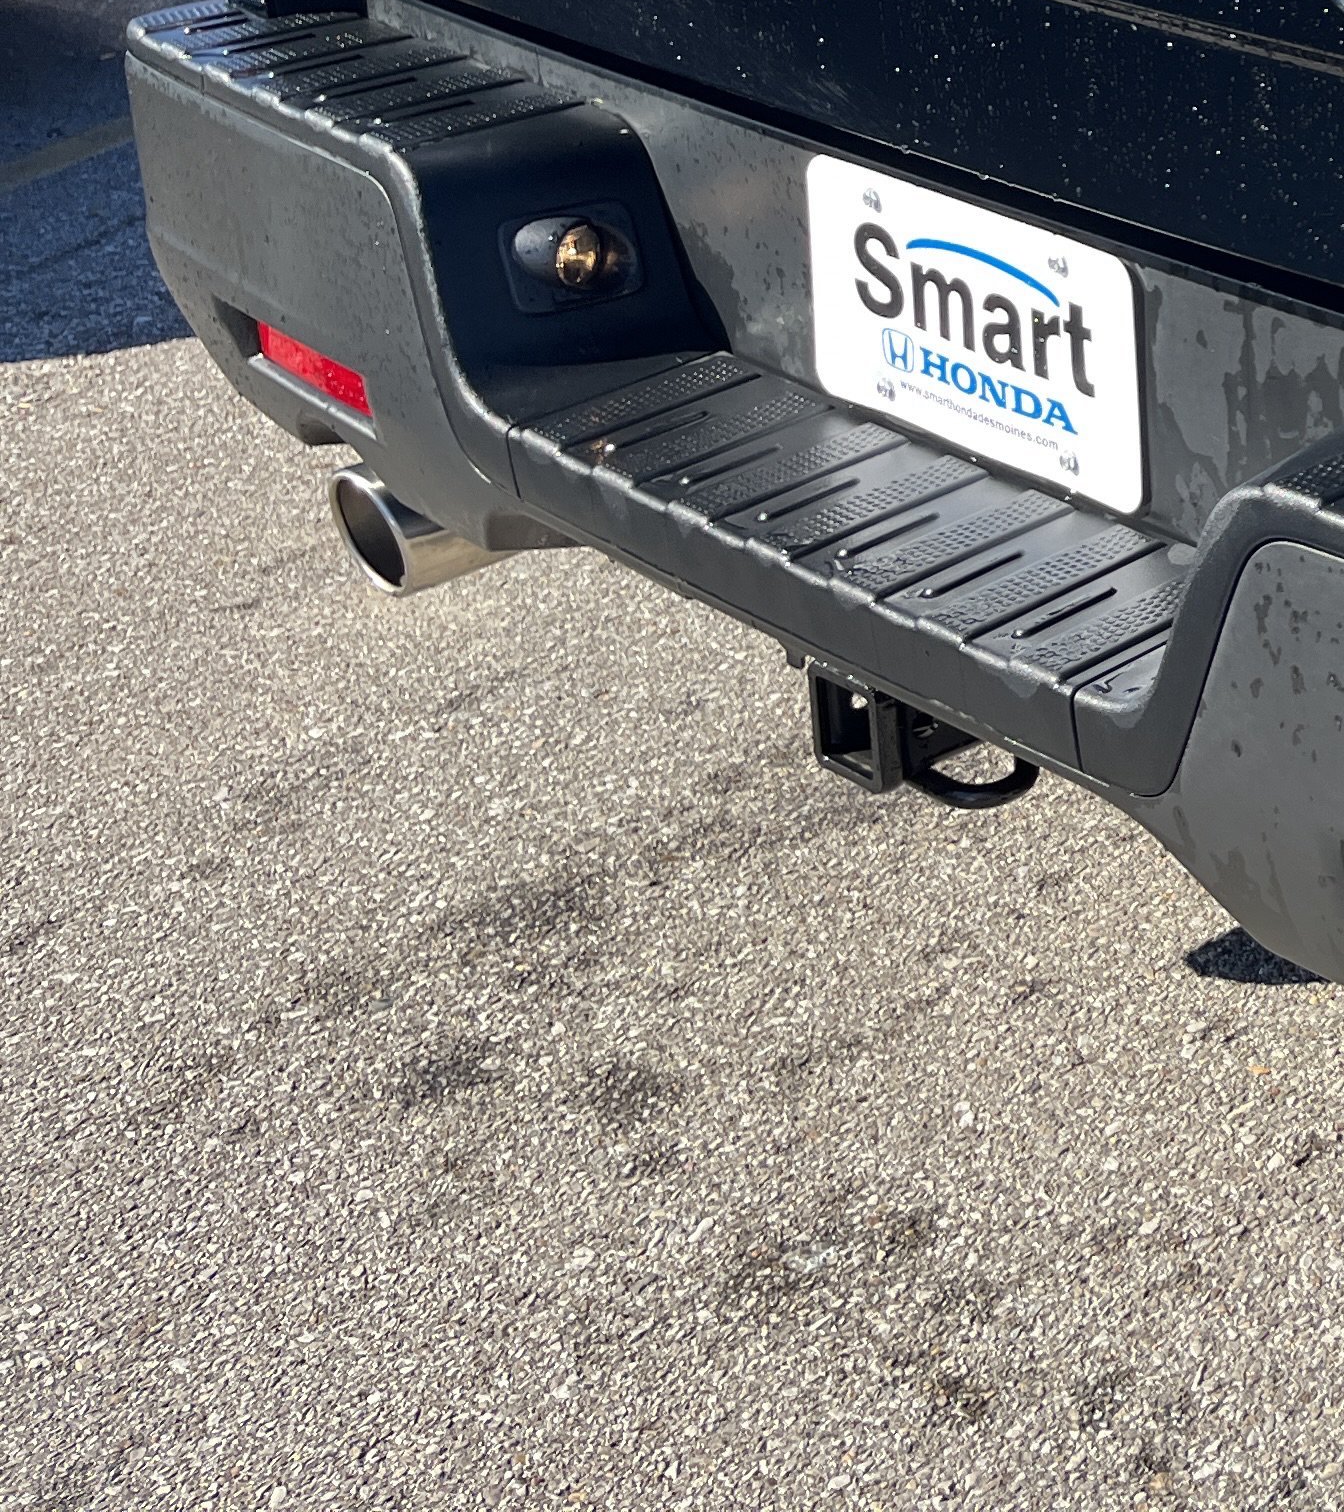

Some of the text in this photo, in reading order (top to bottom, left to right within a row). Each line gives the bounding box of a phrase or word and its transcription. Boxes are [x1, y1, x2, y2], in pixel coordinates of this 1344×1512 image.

[853, 221, 1096, 397] Smart
[899, 379, 1060, 452] www.smarthondadesmoines.com
[920, 346, 1079, 436] HONDA
